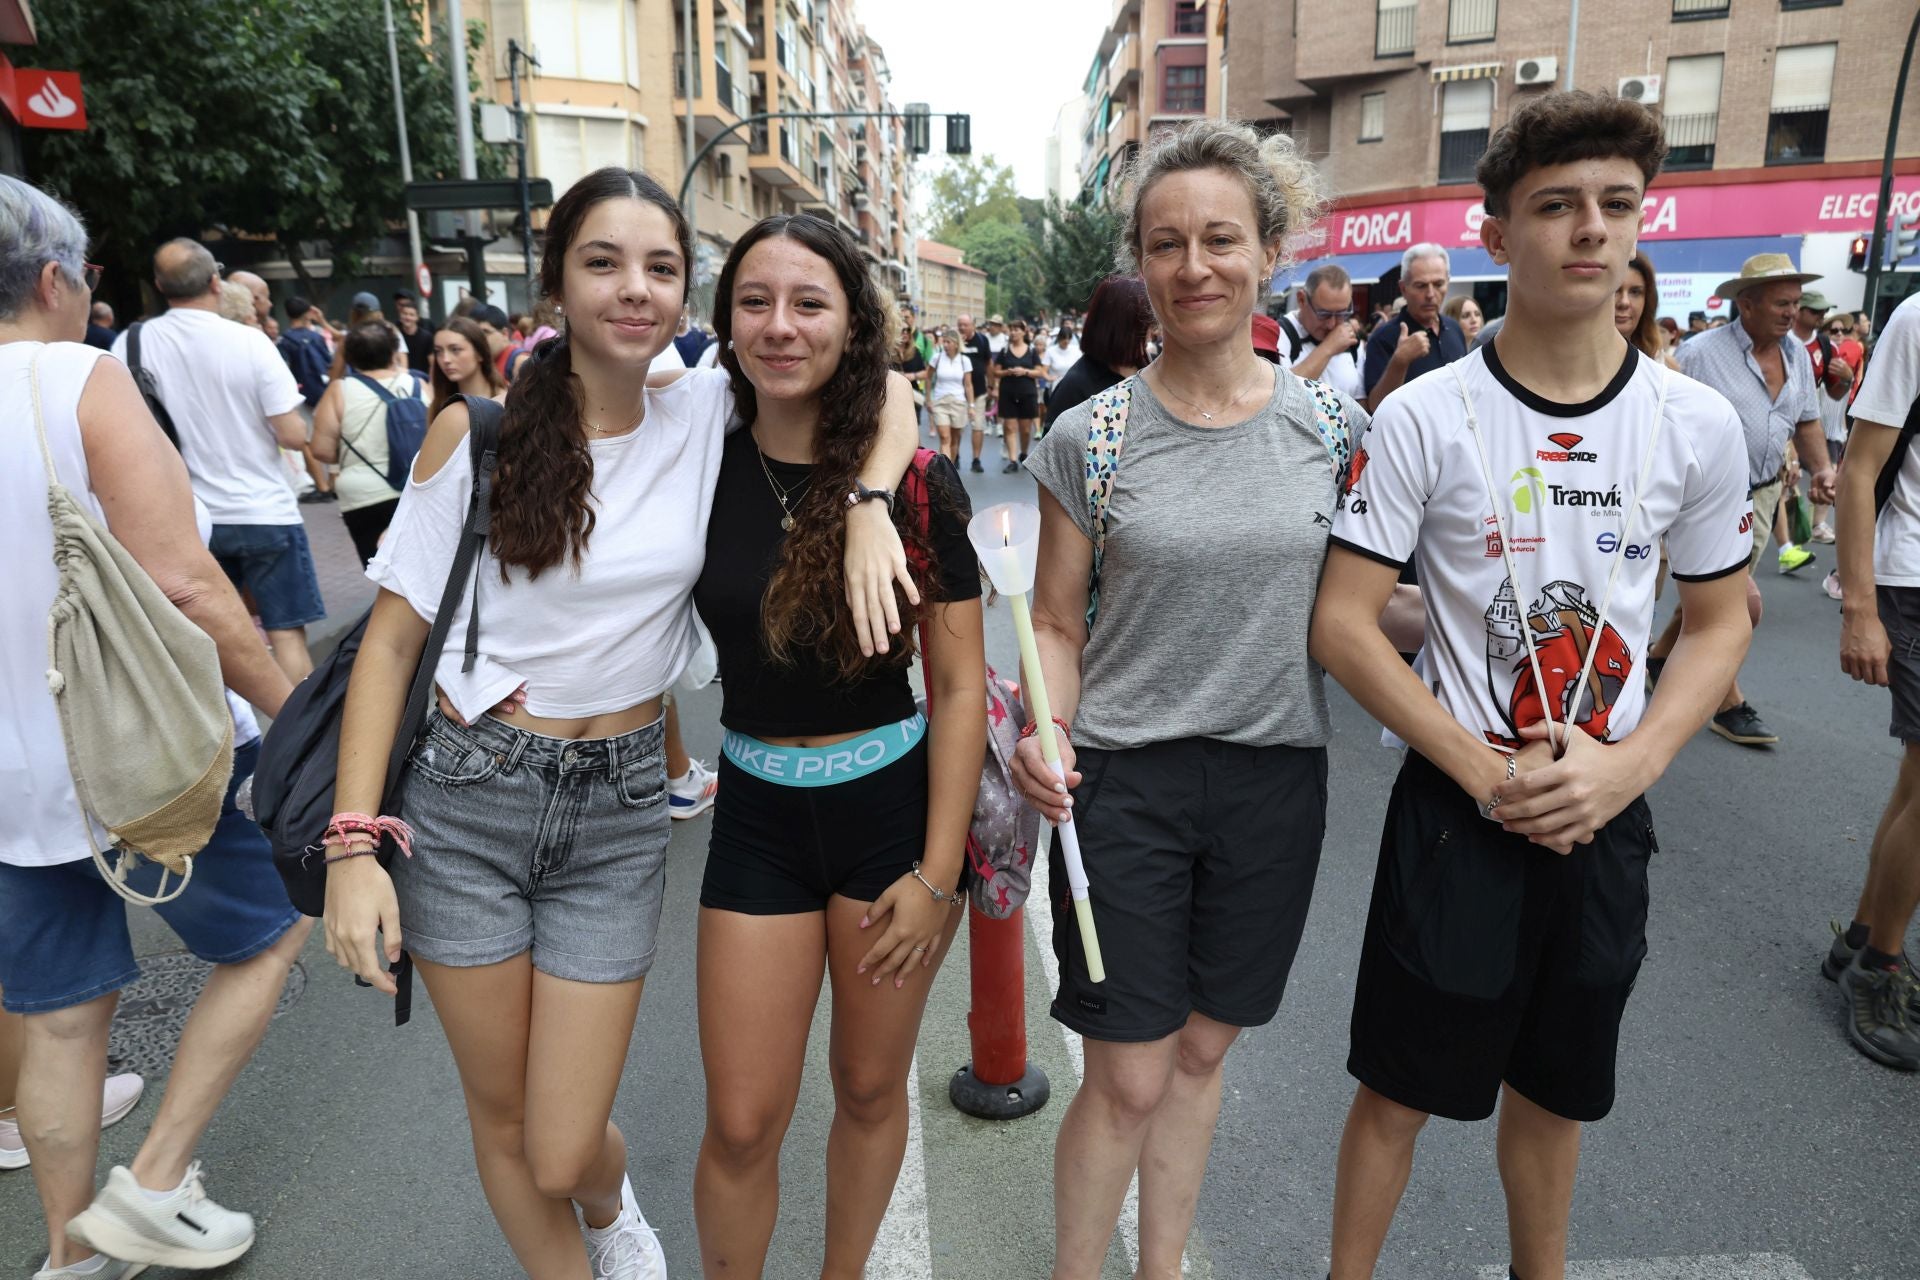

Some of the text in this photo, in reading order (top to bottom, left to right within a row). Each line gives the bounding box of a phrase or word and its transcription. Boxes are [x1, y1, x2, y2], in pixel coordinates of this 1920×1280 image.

[1818, 191, 1920, 220] ELECRO
[1340, 210, 1412, 249] FORCA
[723, 734, 788, 777] NIKE
[795, 740, 886, 779] PRO
